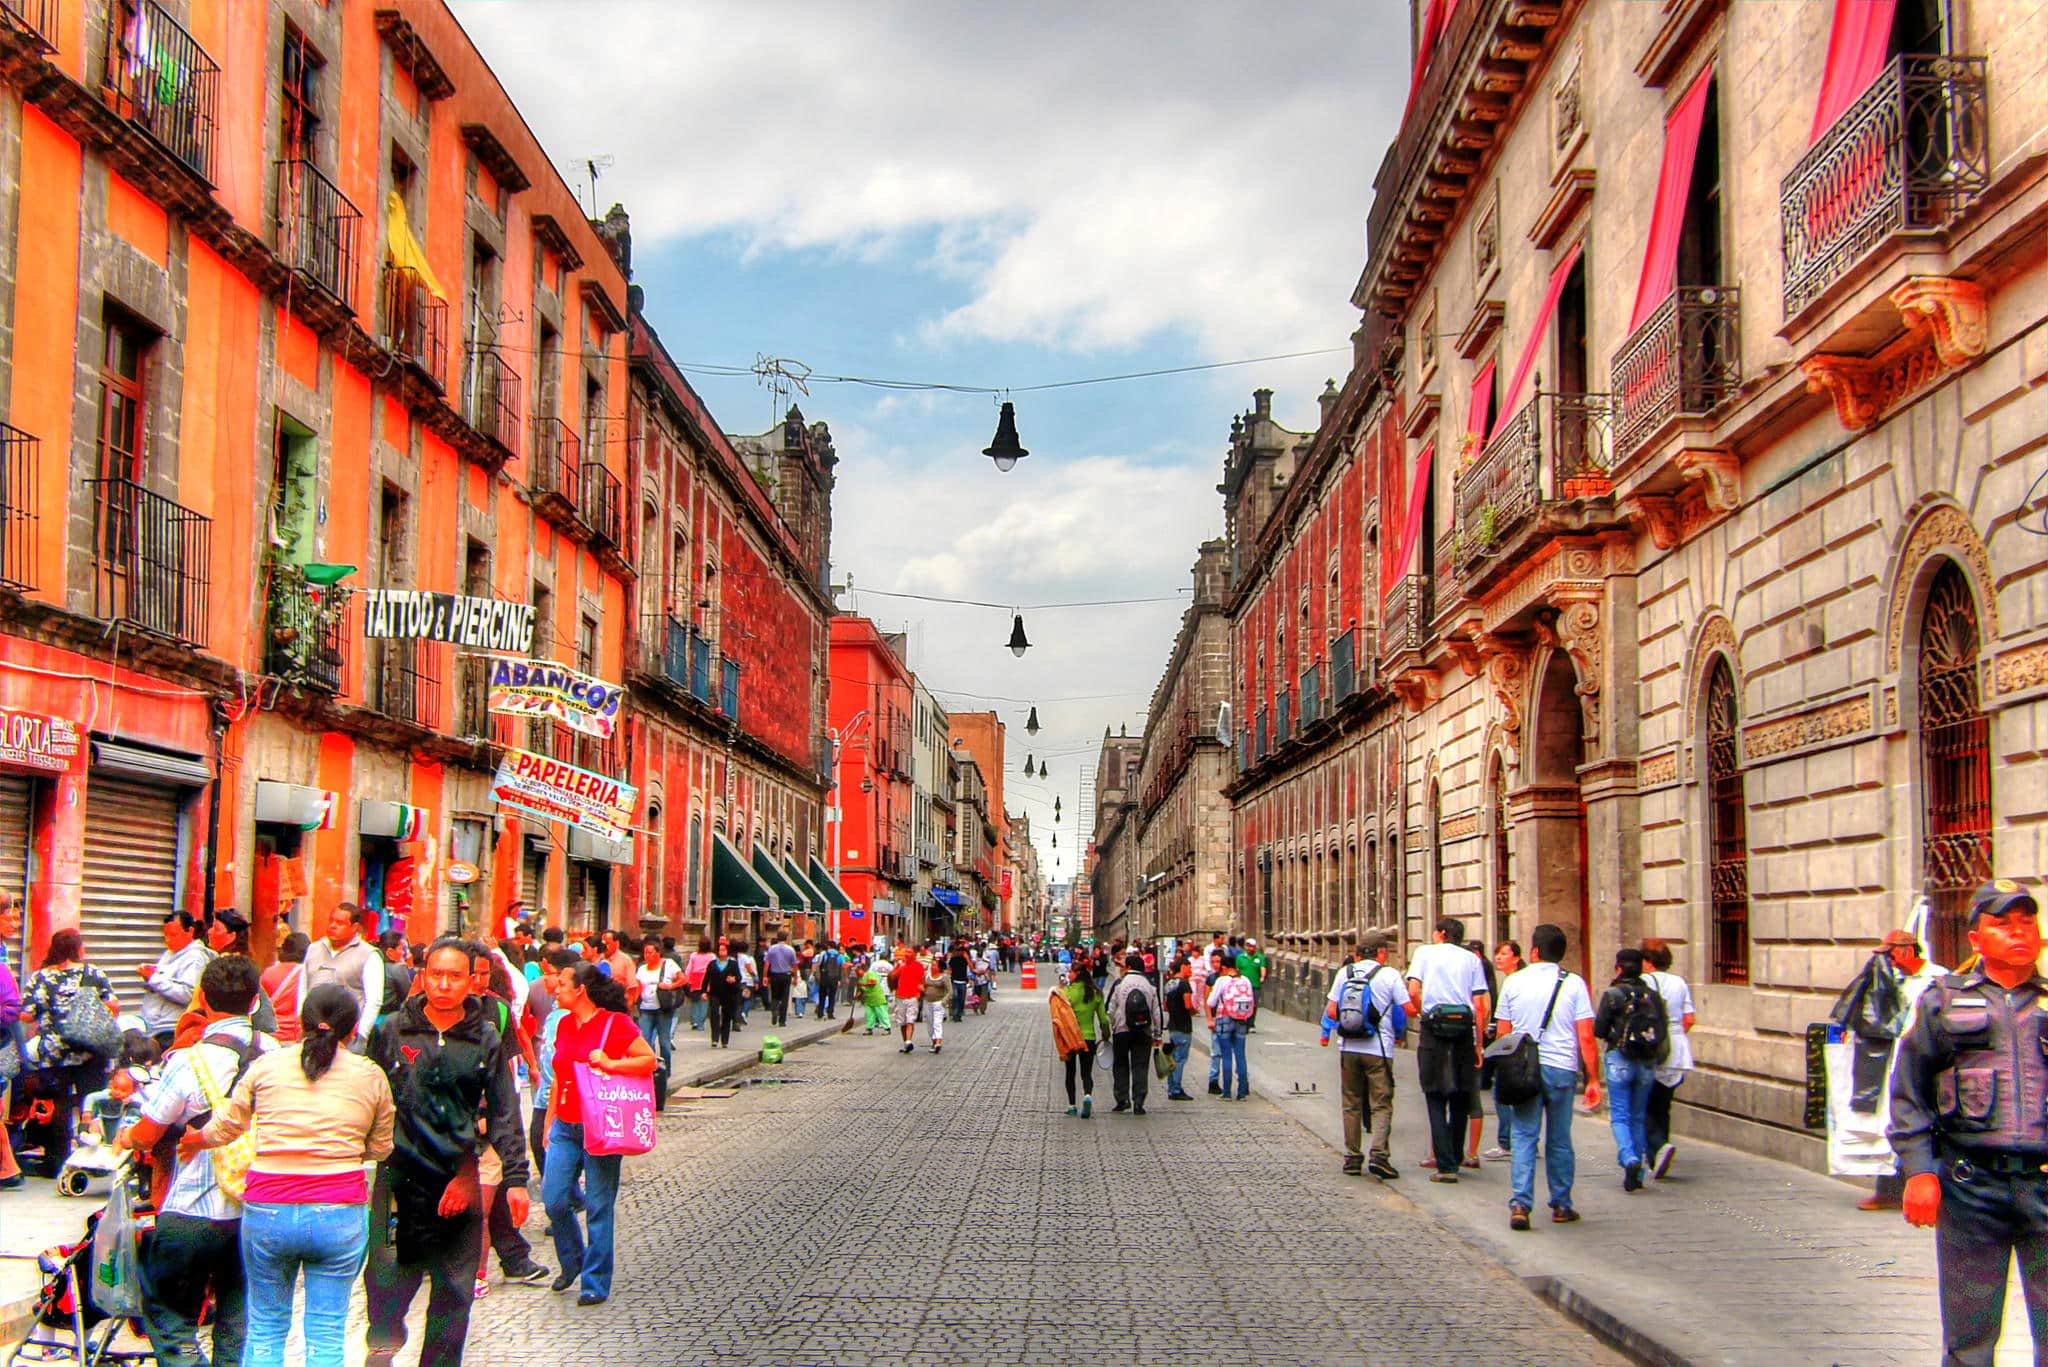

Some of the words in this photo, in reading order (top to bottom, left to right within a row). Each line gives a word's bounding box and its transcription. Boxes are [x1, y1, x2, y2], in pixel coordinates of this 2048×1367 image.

[367, 589, 435, 637] TATTOO
[435, 606, 445, 640] &
[448, 595, 536, 652] PIERCING
[493, 659, 622, 716] ABANICOS
[516, 753, 619, 808] PAPELERIA
